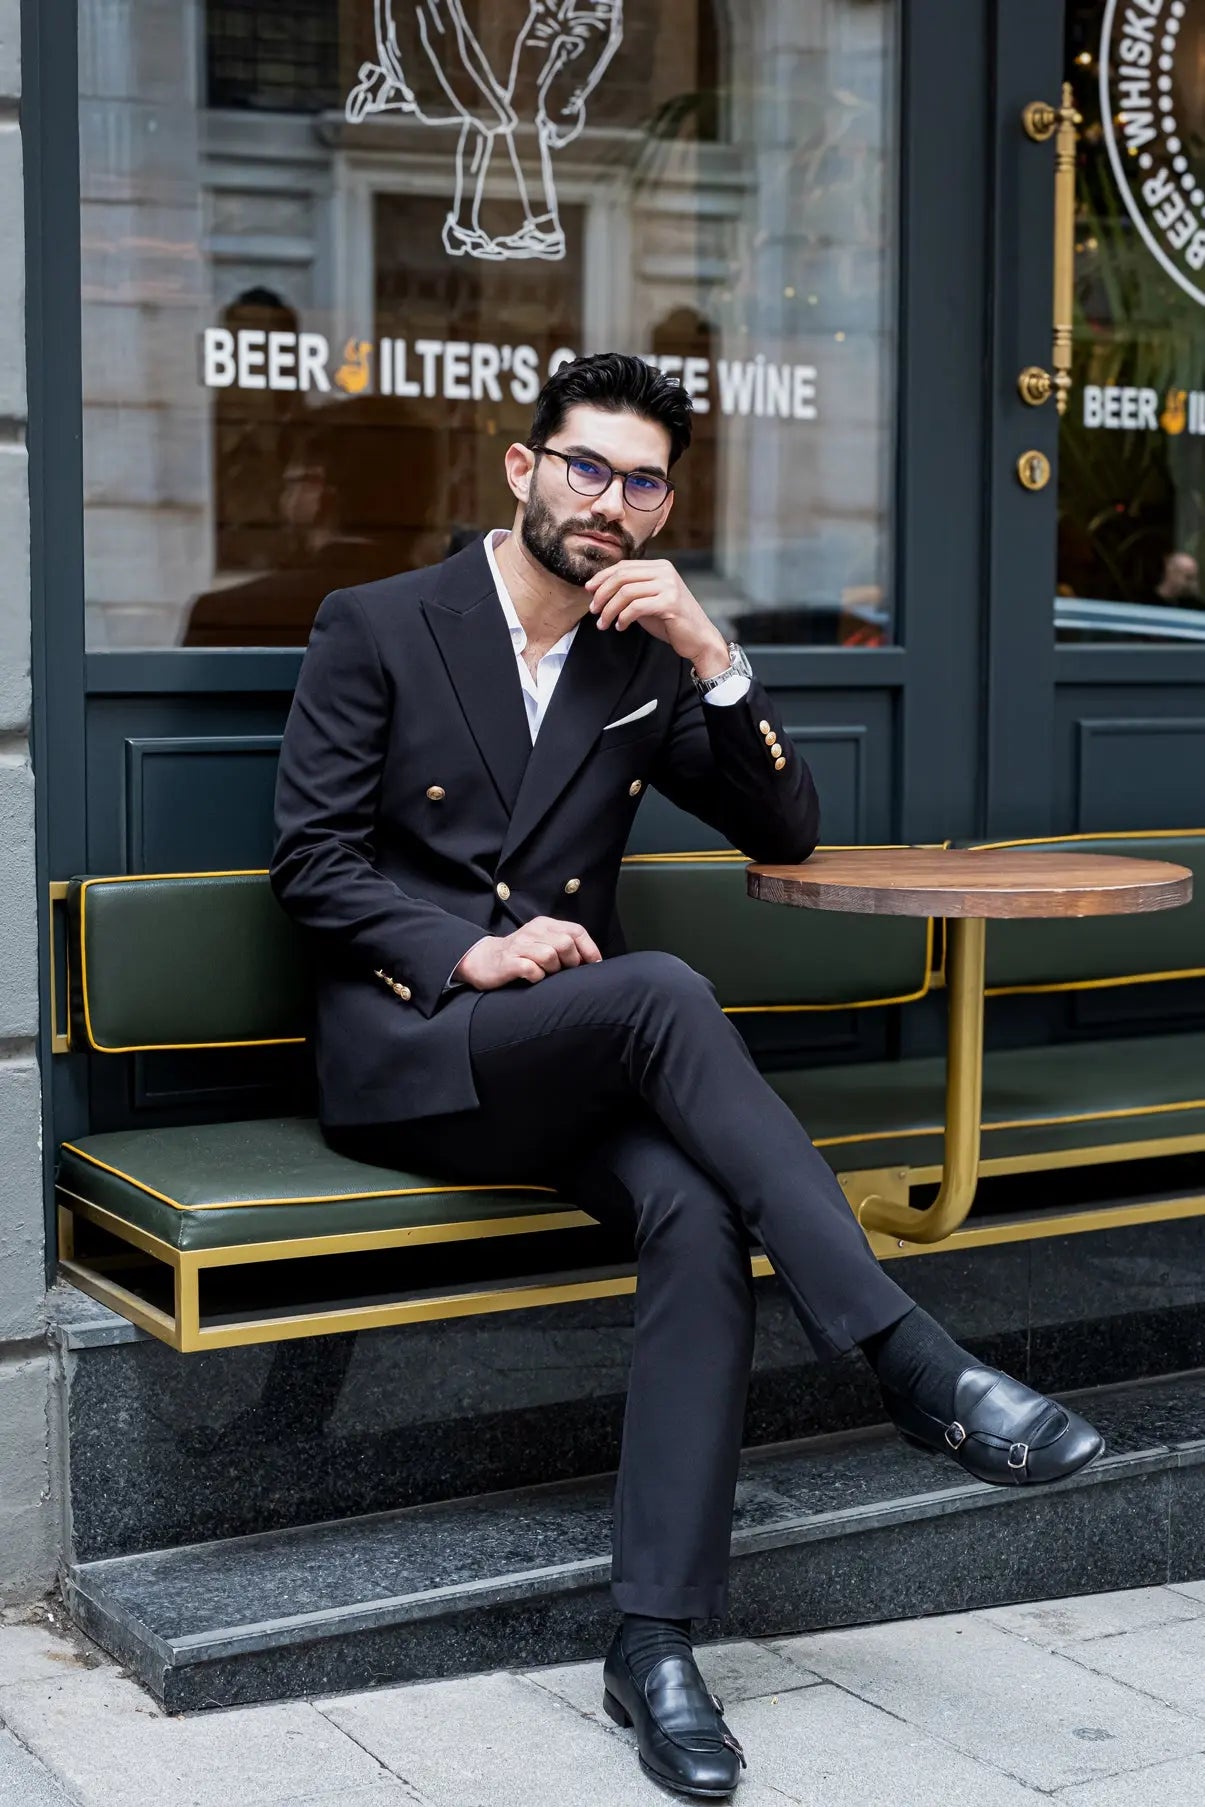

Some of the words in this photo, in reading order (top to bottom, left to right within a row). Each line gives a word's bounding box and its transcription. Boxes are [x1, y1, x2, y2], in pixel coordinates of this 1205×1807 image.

[1141, 166, 1205, 270] BEER
[203, 328, 331, 392] BEER
[380, 337, 540, 404] ILTER'S
[1083, 385, 1159, 431] BEER
